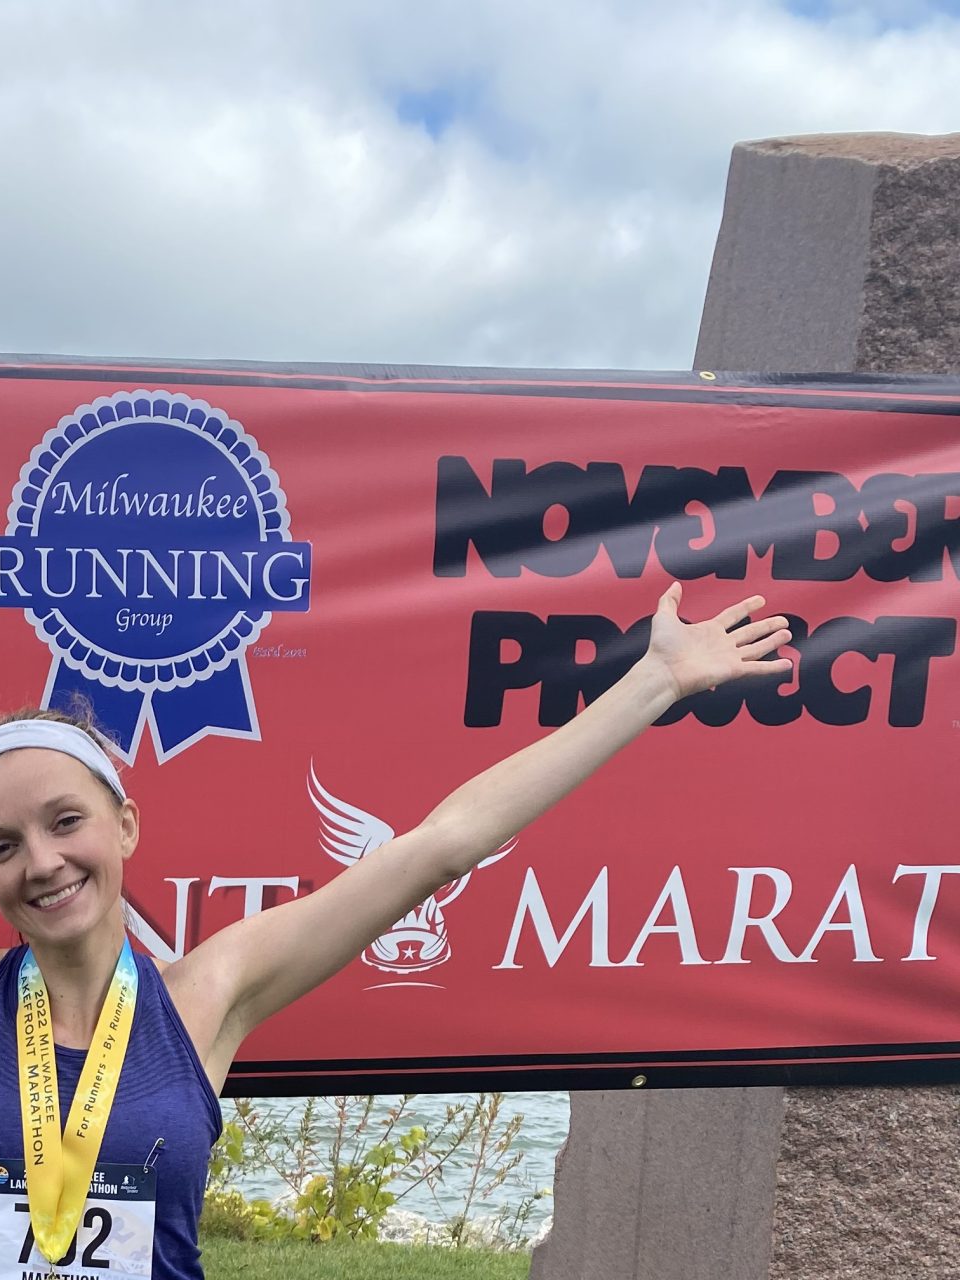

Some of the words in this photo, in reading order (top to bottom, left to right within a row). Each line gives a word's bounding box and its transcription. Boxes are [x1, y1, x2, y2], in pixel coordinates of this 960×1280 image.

[52, 473, 248, 518] Milwaukee
[115, 608, 173, 636] Group
[464, 610, 957, 728] PRECT
[492, 863, 960, 969] MARAT
[20, 962, 37, 1056] LAKEFRONT
[35, 989, 48, 1029] 2022
[109, 984, 128, 1031] Runners
[103, 1033, 116, 1050] By
[39, 1033, 55, 1123] MILWAUKEE
[81, 1062, 107, 1115] Runners
[27, 1063, 44, 1166] MARATHON
[77, 1118, 90, 1139] For
[13, 1202, 113, 1269] 72
